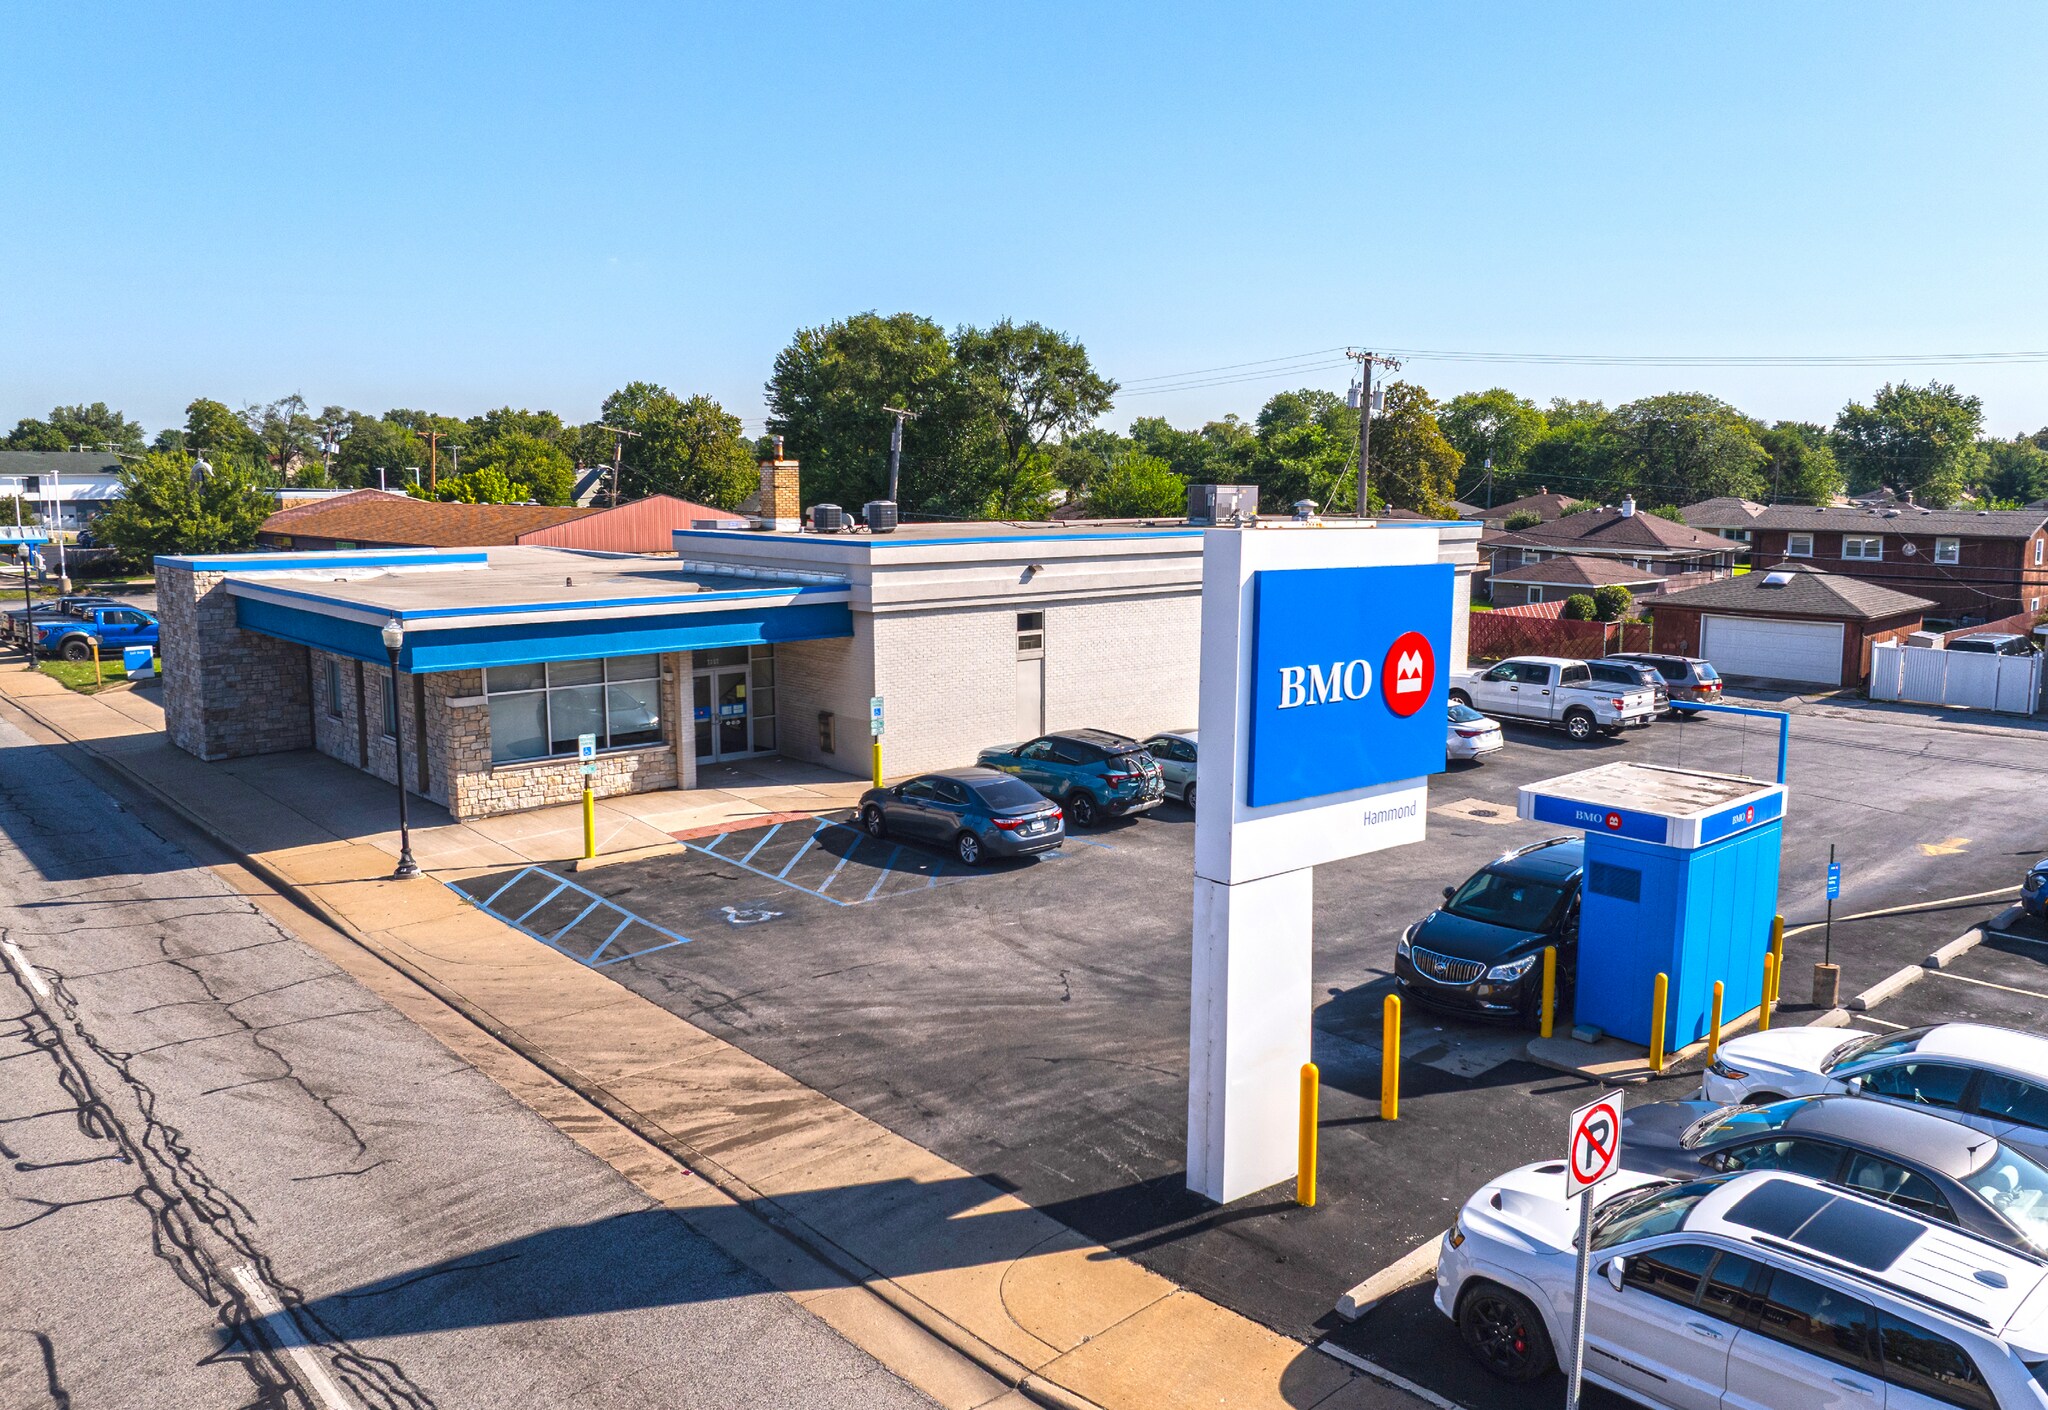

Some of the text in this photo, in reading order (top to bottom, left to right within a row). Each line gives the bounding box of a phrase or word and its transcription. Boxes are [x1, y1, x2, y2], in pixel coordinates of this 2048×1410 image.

[1278, 659, 1373, 710] BMO
[1364, 800, 1416, 826] Hammond
[1576, 810, 1603, 823] BMO
[1732, 812, 1746, 825] BMO
[1586, 1119, 1609, 1170] P
